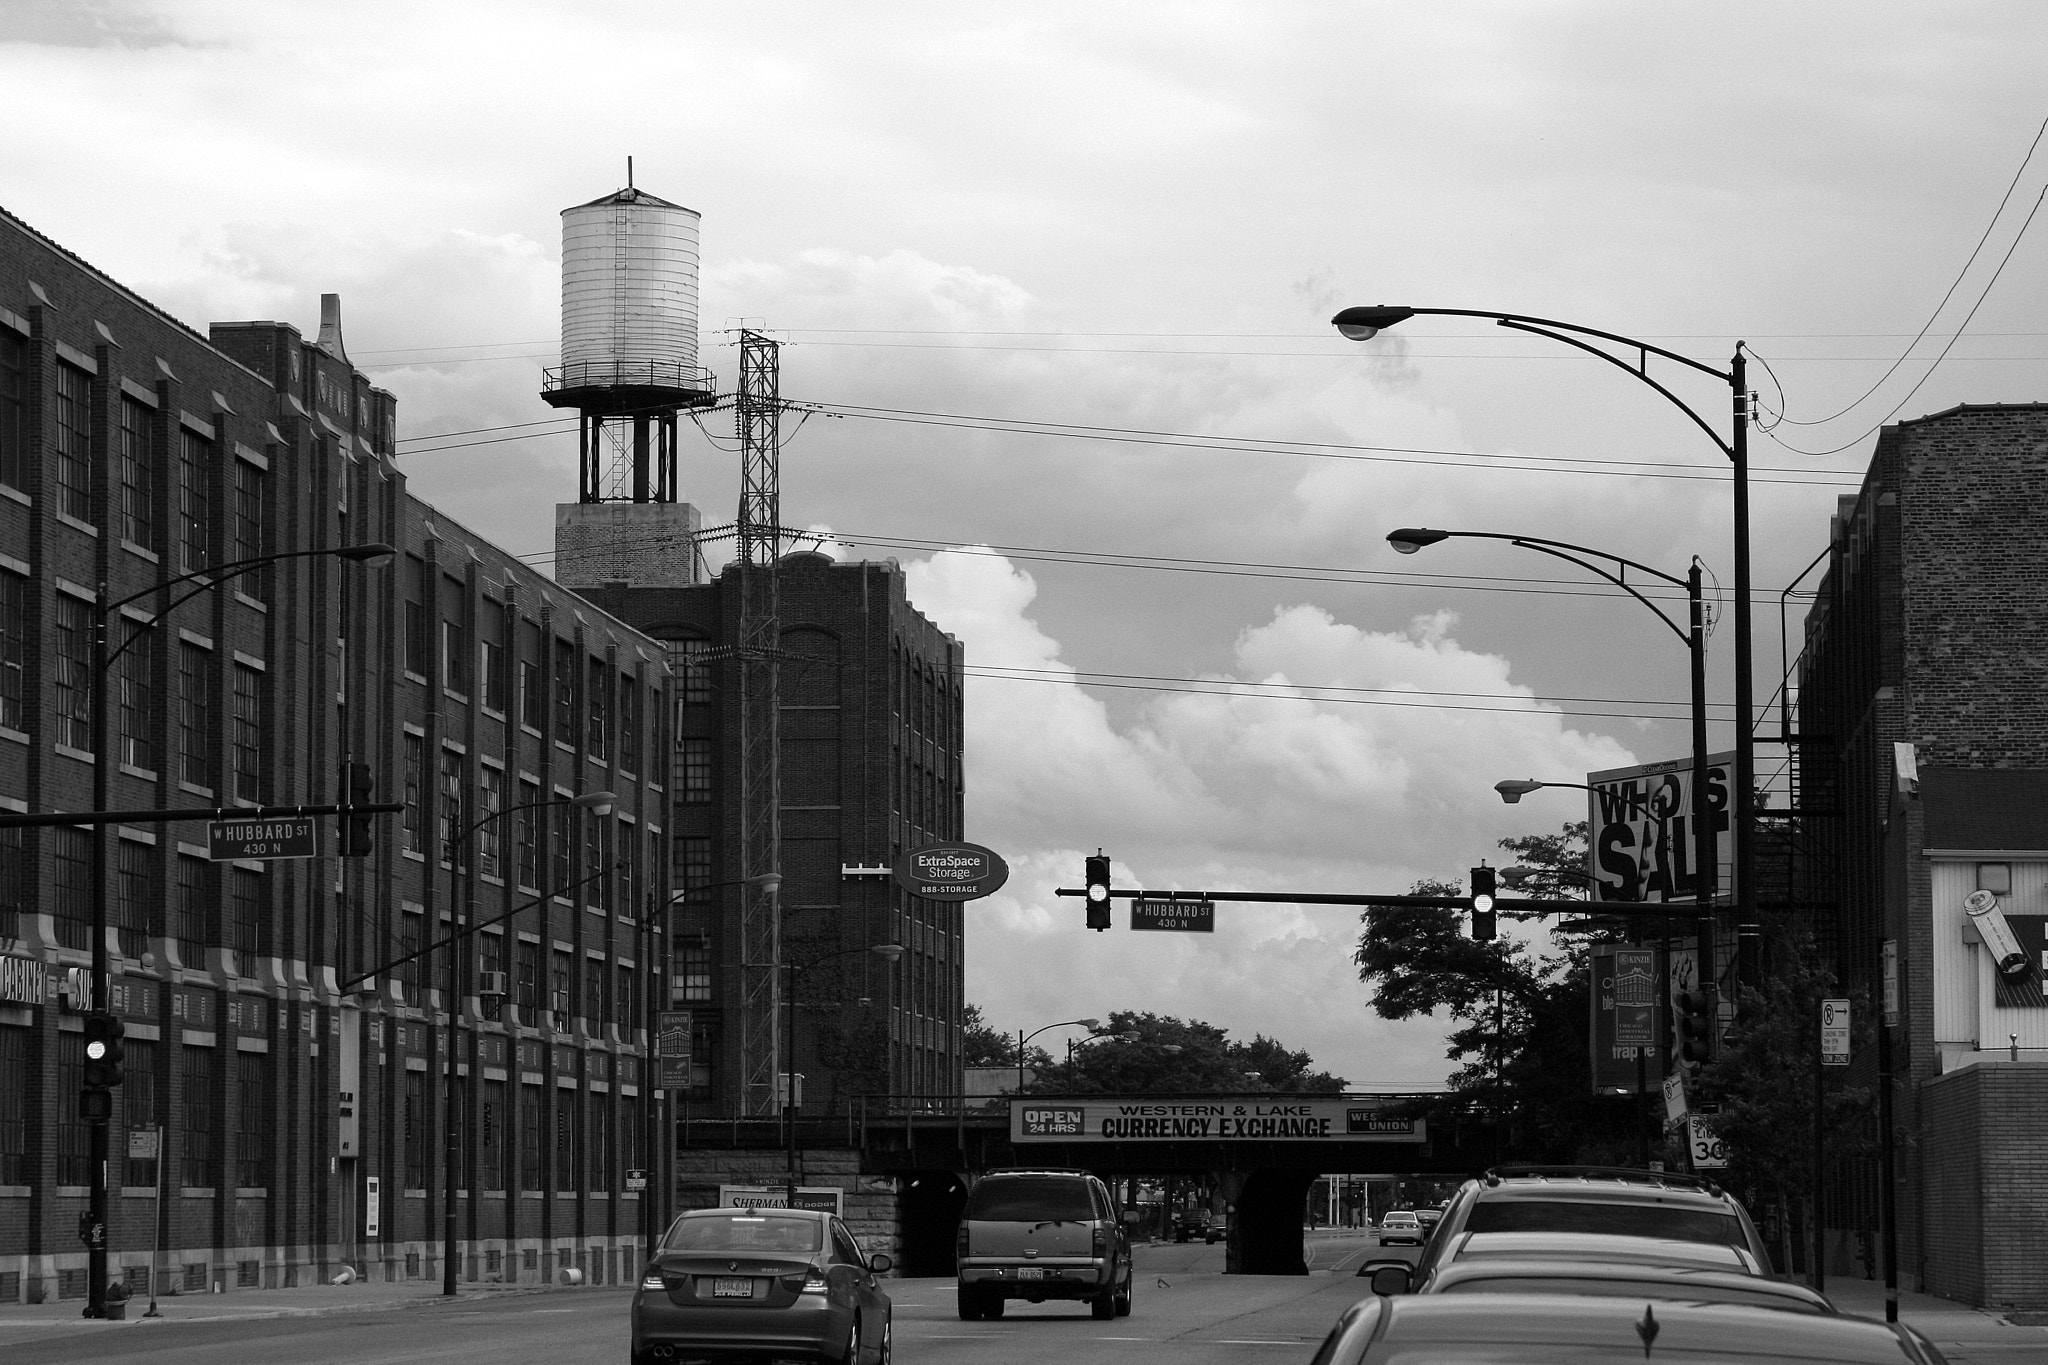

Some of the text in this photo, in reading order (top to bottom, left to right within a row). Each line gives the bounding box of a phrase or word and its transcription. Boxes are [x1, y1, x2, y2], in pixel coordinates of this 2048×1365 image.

[1598, 773, 1682, 826] WHO
[214, 824, 309, 841] W HUBBARD ST
[243, 843, 281, 854] 430 N
[1598, 811, 1730, 903] SALT
[929, 866, 970, 880] Storage
[1136, 904, 1210, 917] W HUBBARD ST
[1157, 919, 1188, 928] 430 N
[1630, 955, 1651, 964] KINZIE
[1823, 1054, 1848, 1063] TOW ZONE
[1118, 1105, 1312, 1116] WESTERN & LAKE
[1025, 1111, 1082, 1124] OPEN
[1030, 1124, 1077, 1133] 24 HRS
[1102, 1118, 1331, 1139] CURRENCY EXCHANGE
[1369, 1121, 1409, 1131] UNION
[733, 1197, 789, 1209] SHERMAN
